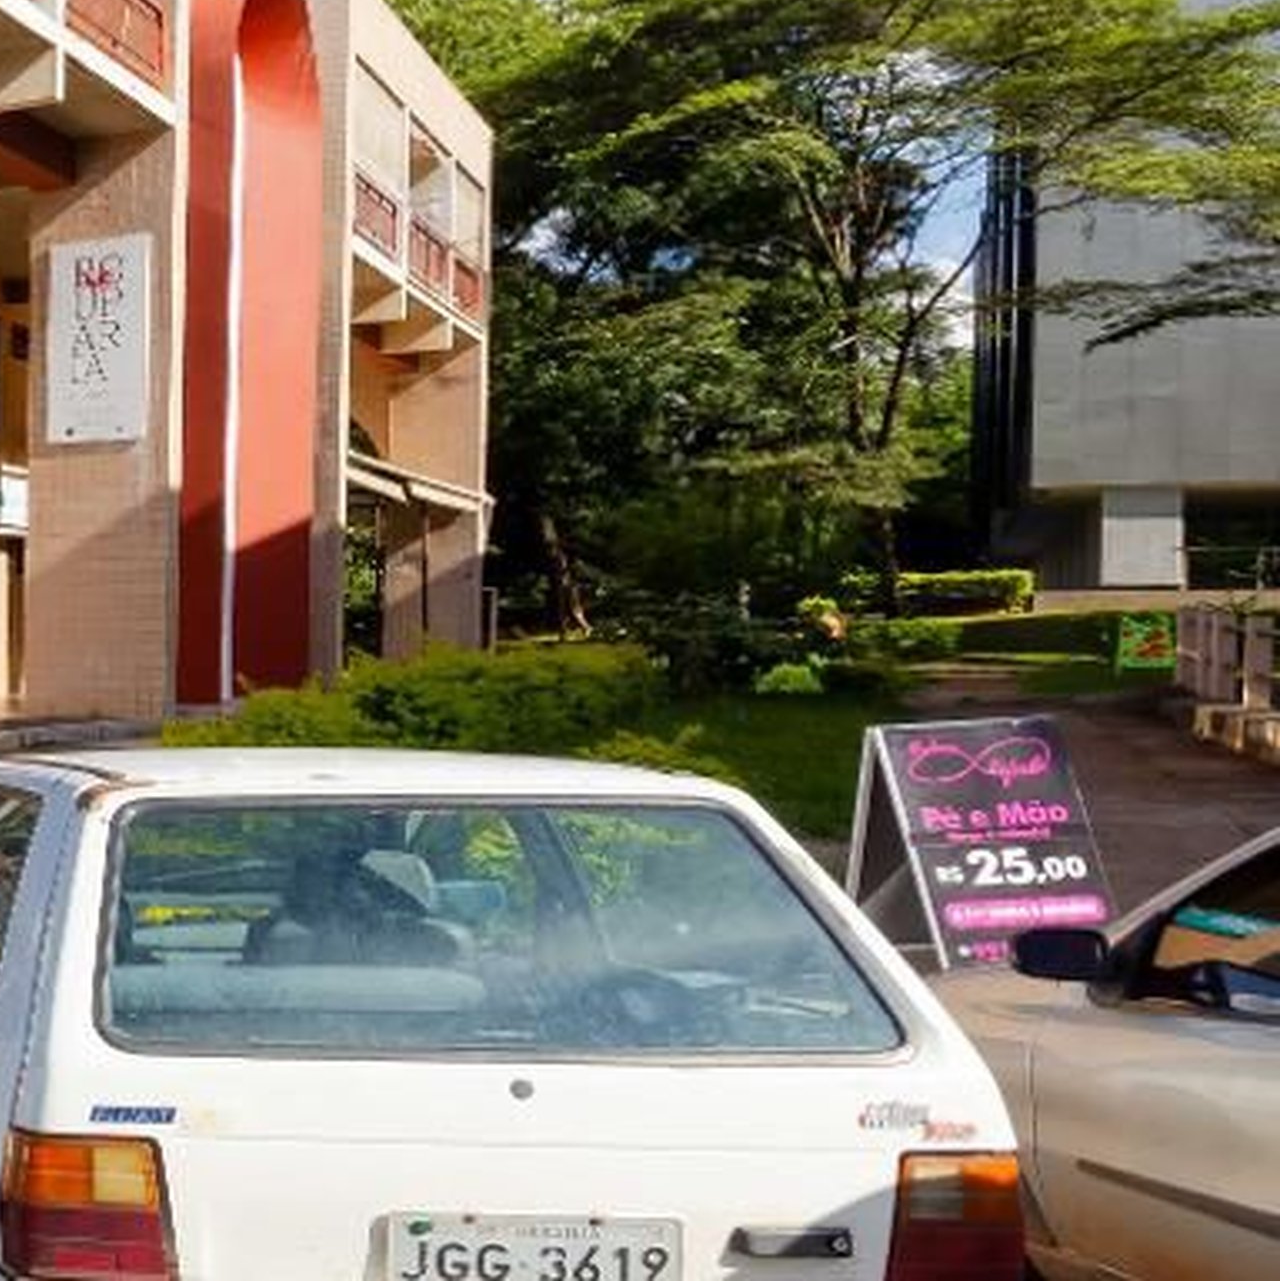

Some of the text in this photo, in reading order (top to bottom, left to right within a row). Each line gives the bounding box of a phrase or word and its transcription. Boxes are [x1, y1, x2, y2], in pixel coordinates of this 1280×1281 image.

[969, 809, 988, 824] e
[997, 799, 1069, 825] Mão
[966, 847, 1088, 886] 25,00
